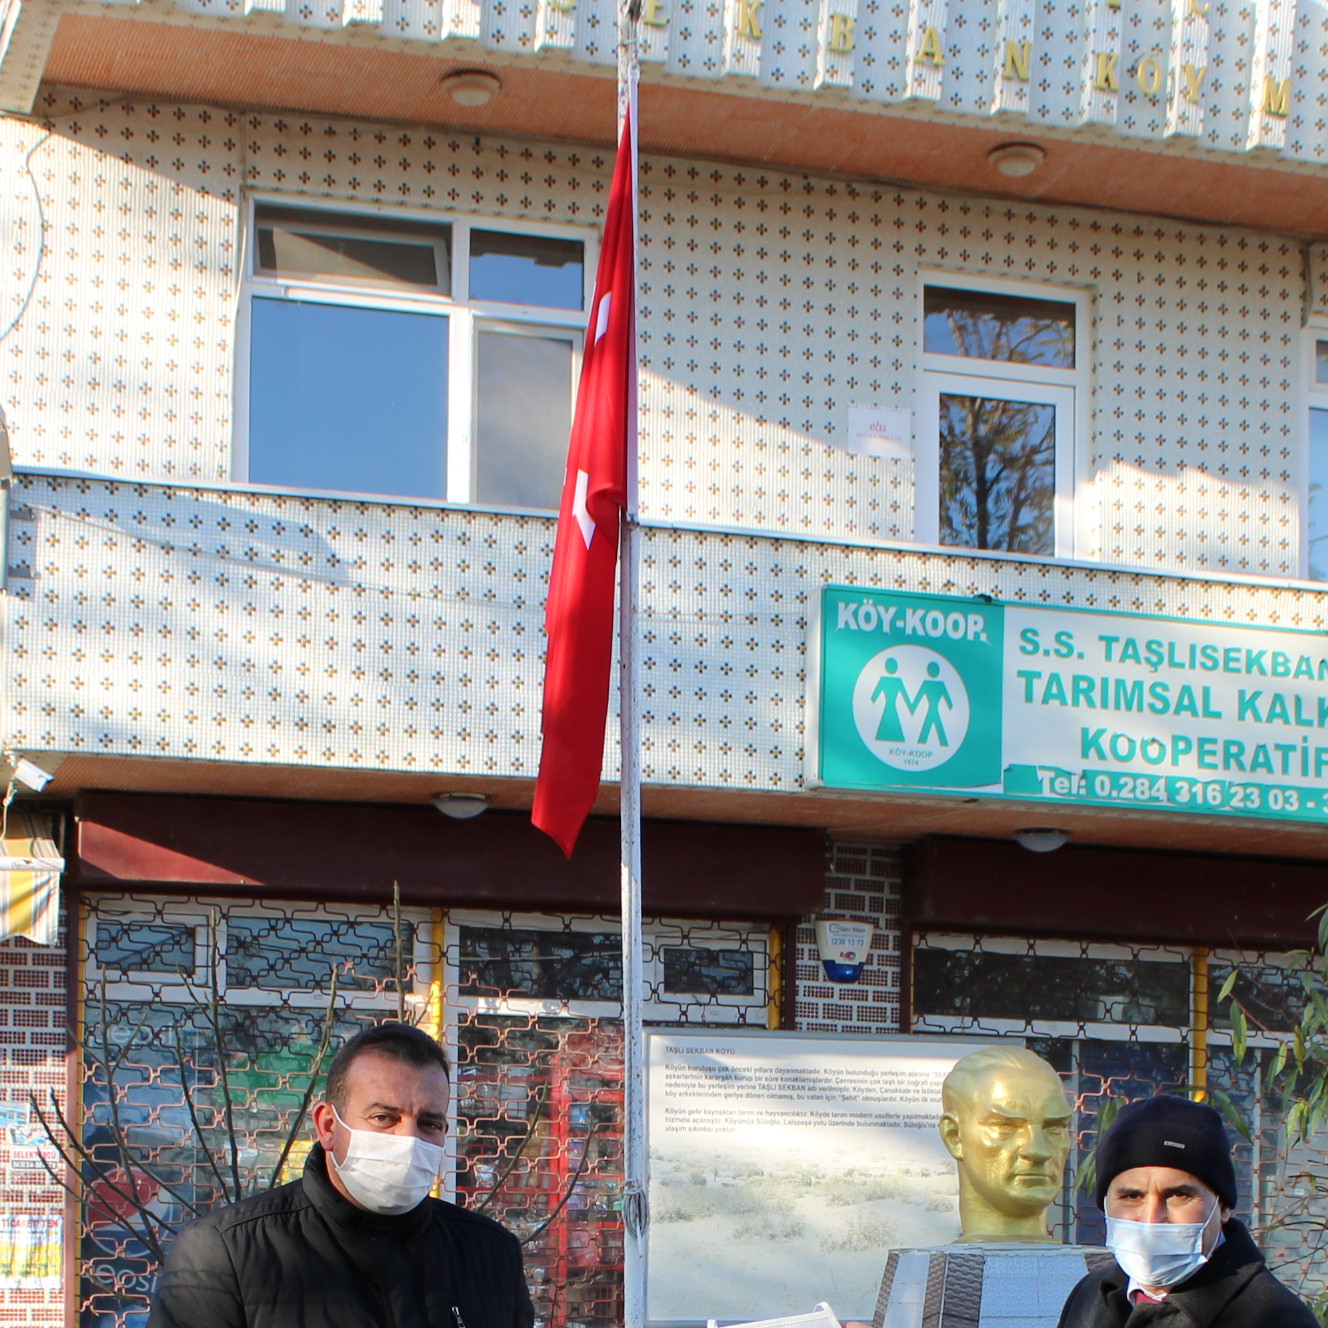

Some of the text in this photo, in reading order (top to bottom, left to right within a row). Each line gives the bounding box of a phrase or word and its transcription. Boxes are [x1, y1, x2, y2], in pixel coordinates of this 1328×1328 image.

[837, 600, 987, 641] KÖY-KOOP.
[1019, 628, 1084, 659] S.S.
[1017, 670, 1222, 719] TARIMSAL
[889, 748, 933, 758] KÖY-KOOP
[1037, 766, 1086, 796] Tel:
[1095, 773, 1167, 802] 0.284
[1175, 780, 1222, 805] 316
[1229, 785, 1261, 809] 23
[1268, 789, 1300, 812] 03
[665, 1064, 686, 1072] Köyün
[688, 1065, 716, 1073] kuruluşu
[846, 1069, 879, 1077] bulunduğu
